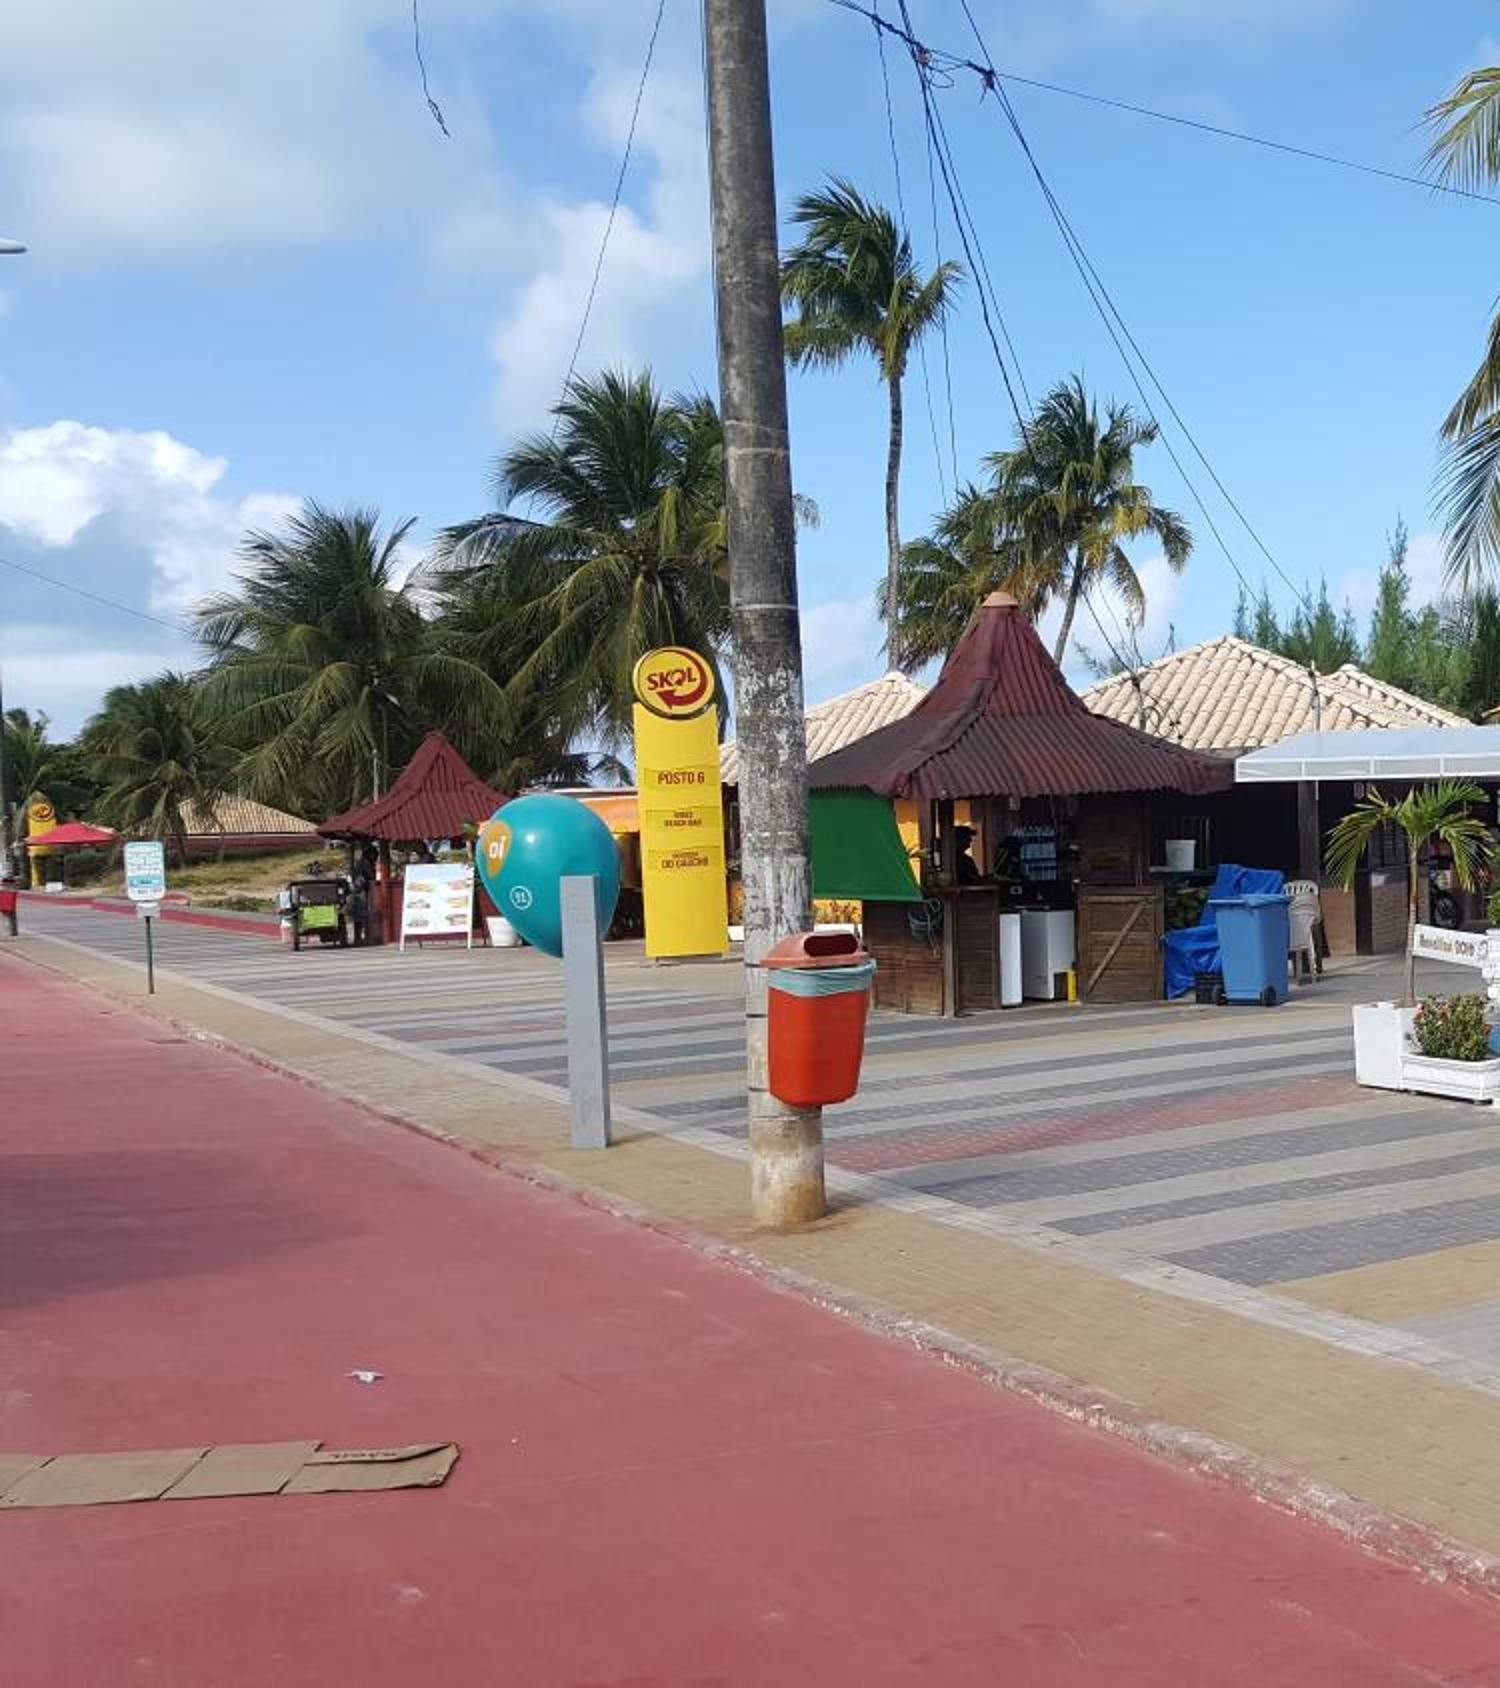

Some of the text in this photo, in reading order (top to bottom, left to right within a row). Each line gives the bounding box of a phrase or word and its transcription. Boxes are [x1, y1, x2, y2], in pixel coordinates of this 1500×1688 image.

[647, 666, 698, 691] SKOL
[657, 770, 705, 785] POSTO 6
